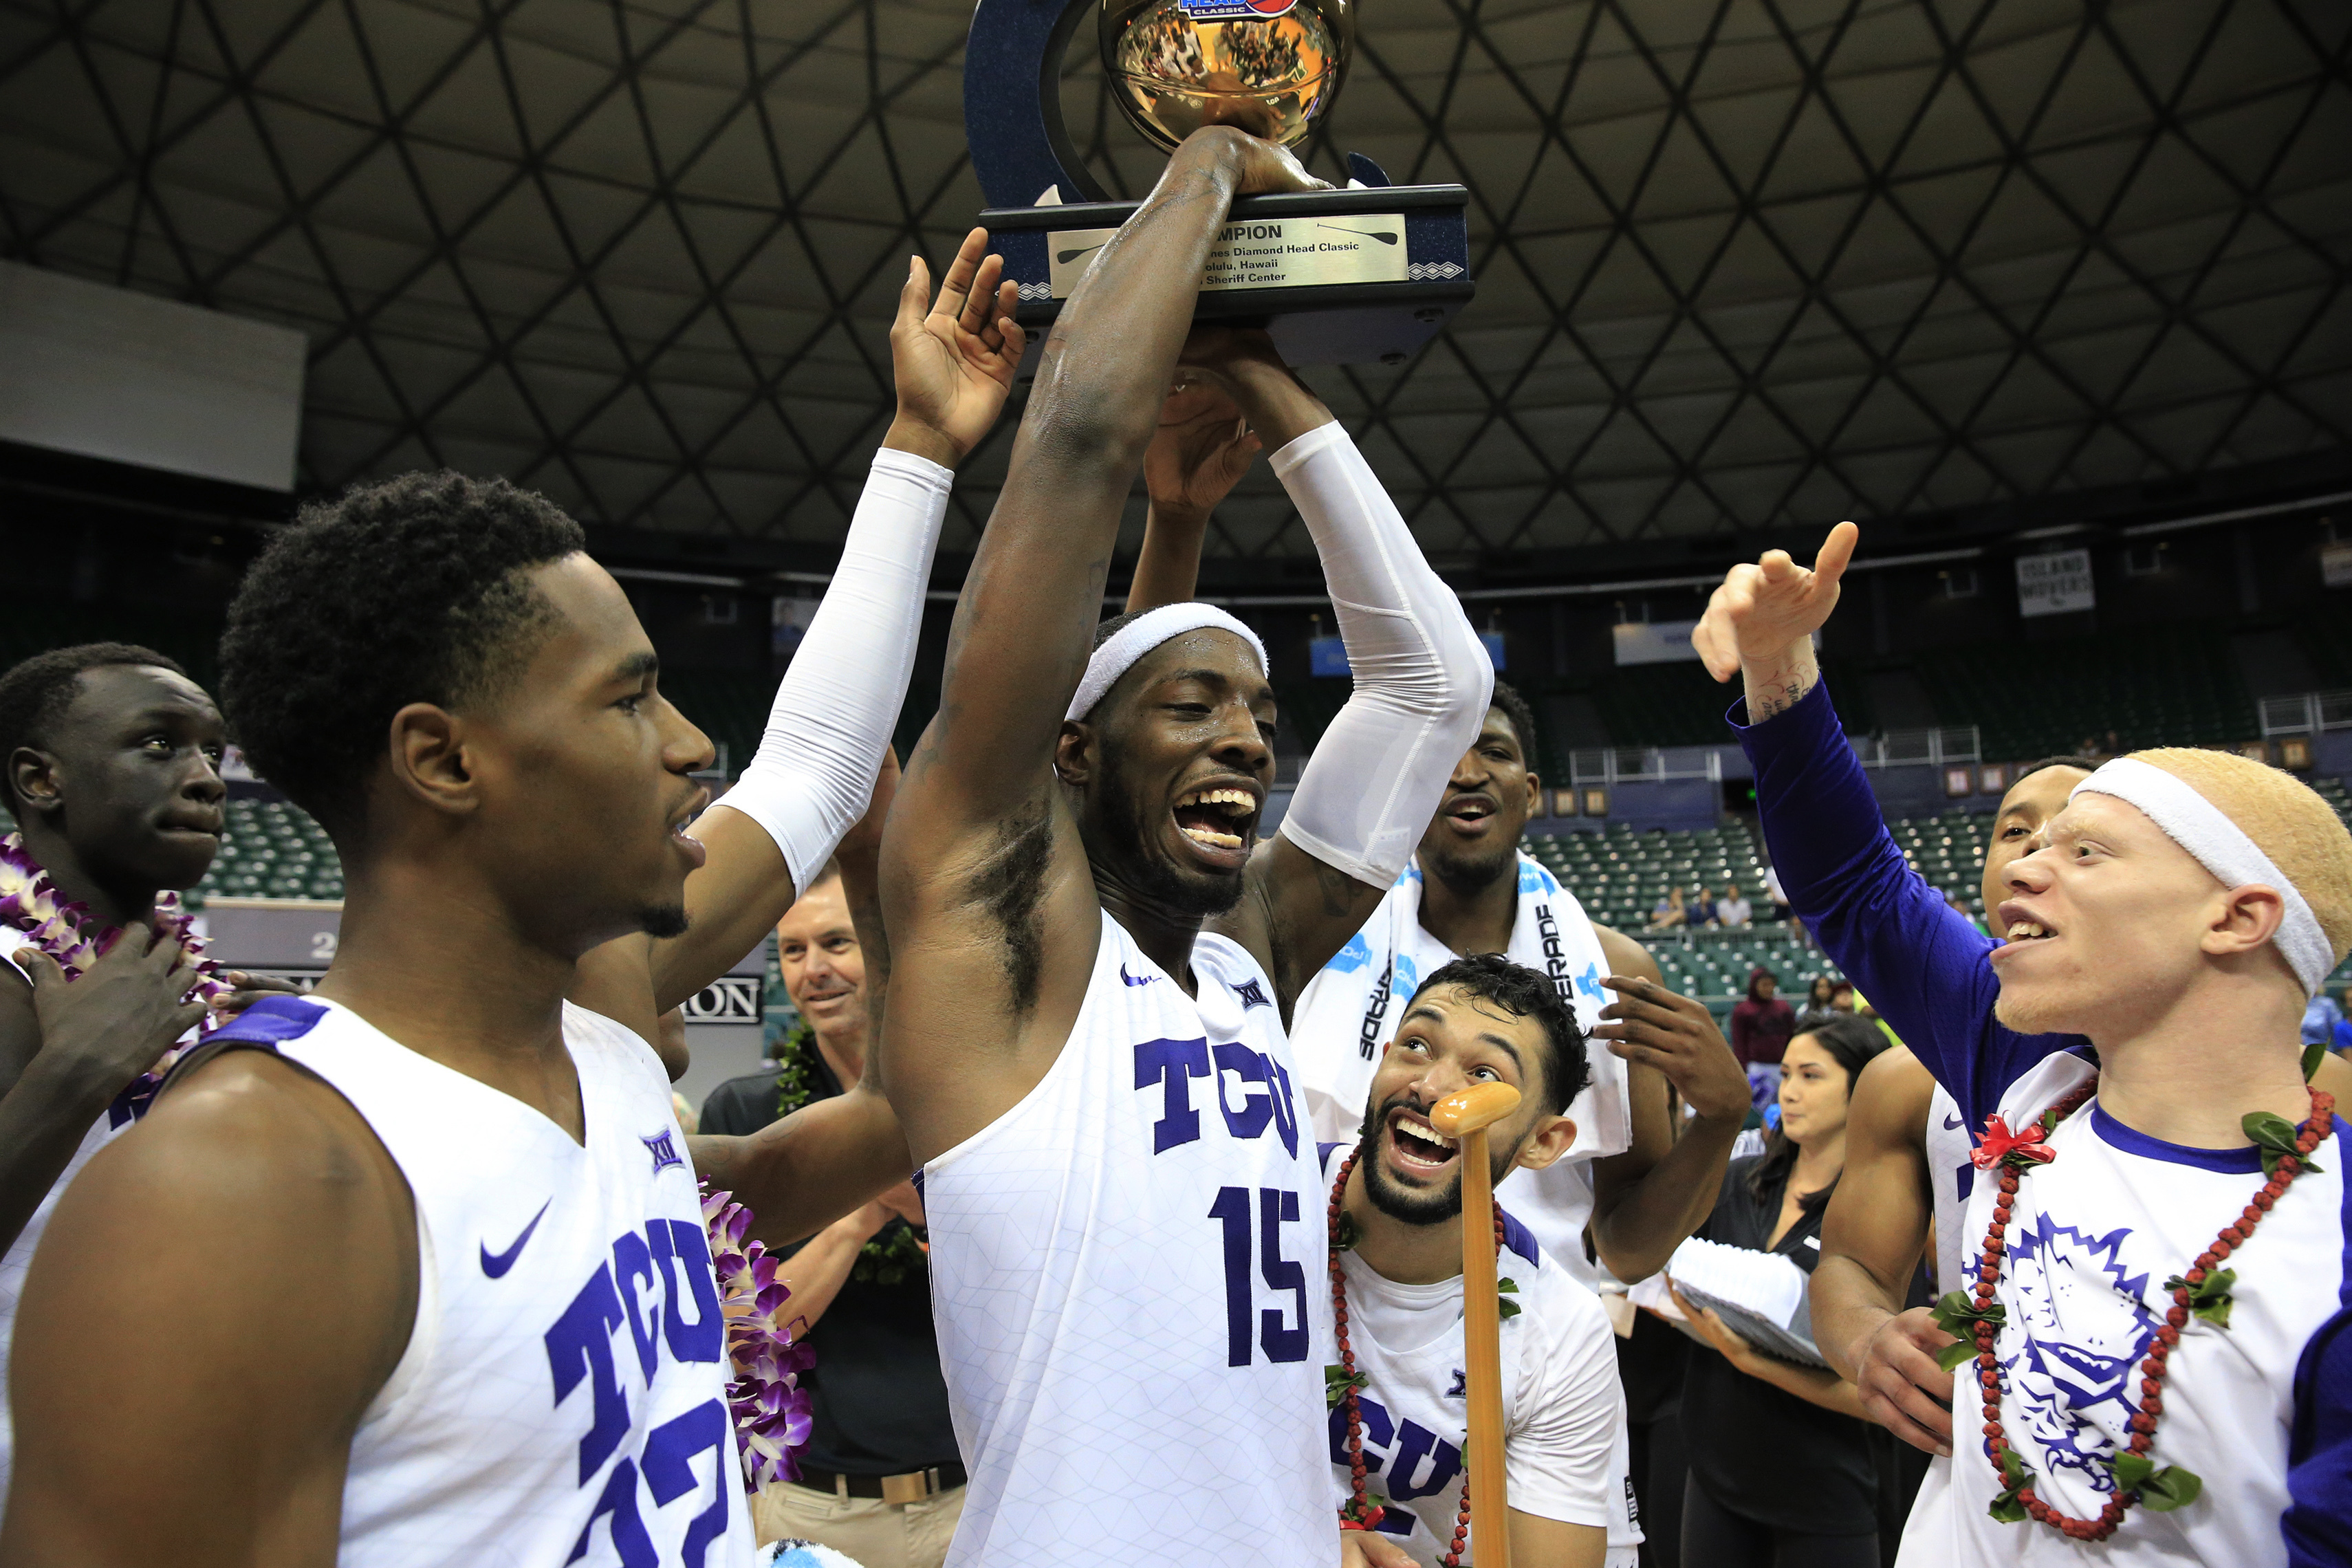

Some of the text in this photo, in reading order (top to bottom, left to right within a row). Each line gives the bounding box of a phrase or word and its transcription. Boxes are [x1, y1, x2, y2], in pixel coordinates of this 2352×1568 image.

[1193, 7, 1245, 15] CLASSIC
[1210, 241, 1360, 259] nes Diamond Head Classic
[1218, 225, 1282, 241] MPION
[1205, 259, 1278, 272] olulu, Hawaii
[1206, 273, 1286, 285] Sheriff Center
[1536, 904, 1574, 999] ERADE
[1134, 1036, 1298, 1160] TCU
[1208, 1186, 1309, 1367] 15
[544, 1218, 723, 1490] TCU
[1329, 1395, 1463, 1501] CU
